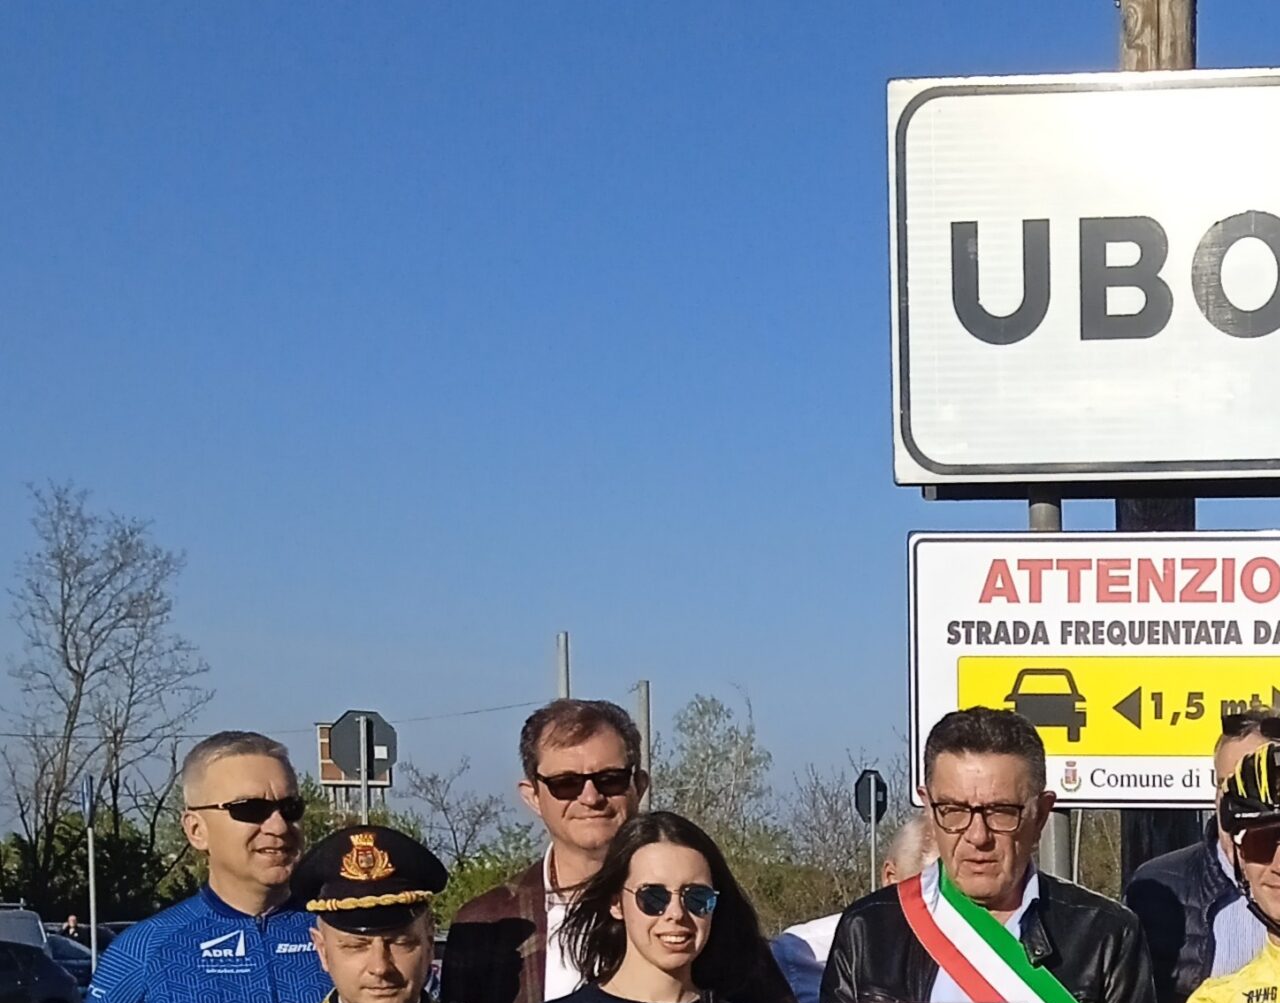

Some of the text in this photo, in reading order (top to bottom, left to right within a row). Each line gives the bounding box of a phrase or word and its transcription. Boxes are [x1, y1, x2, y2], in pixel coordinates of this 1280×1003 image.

[947, 620, 1050, 645] STRADA
[1061, 619, 1242, 648] FREQUENTATA
[1151, 691, 1205, 726] 1,5
[1090, 767, 1175, 788] Comune
[1181, 768, 1200, 788] di
[202, 948, 234, 958] ADR
